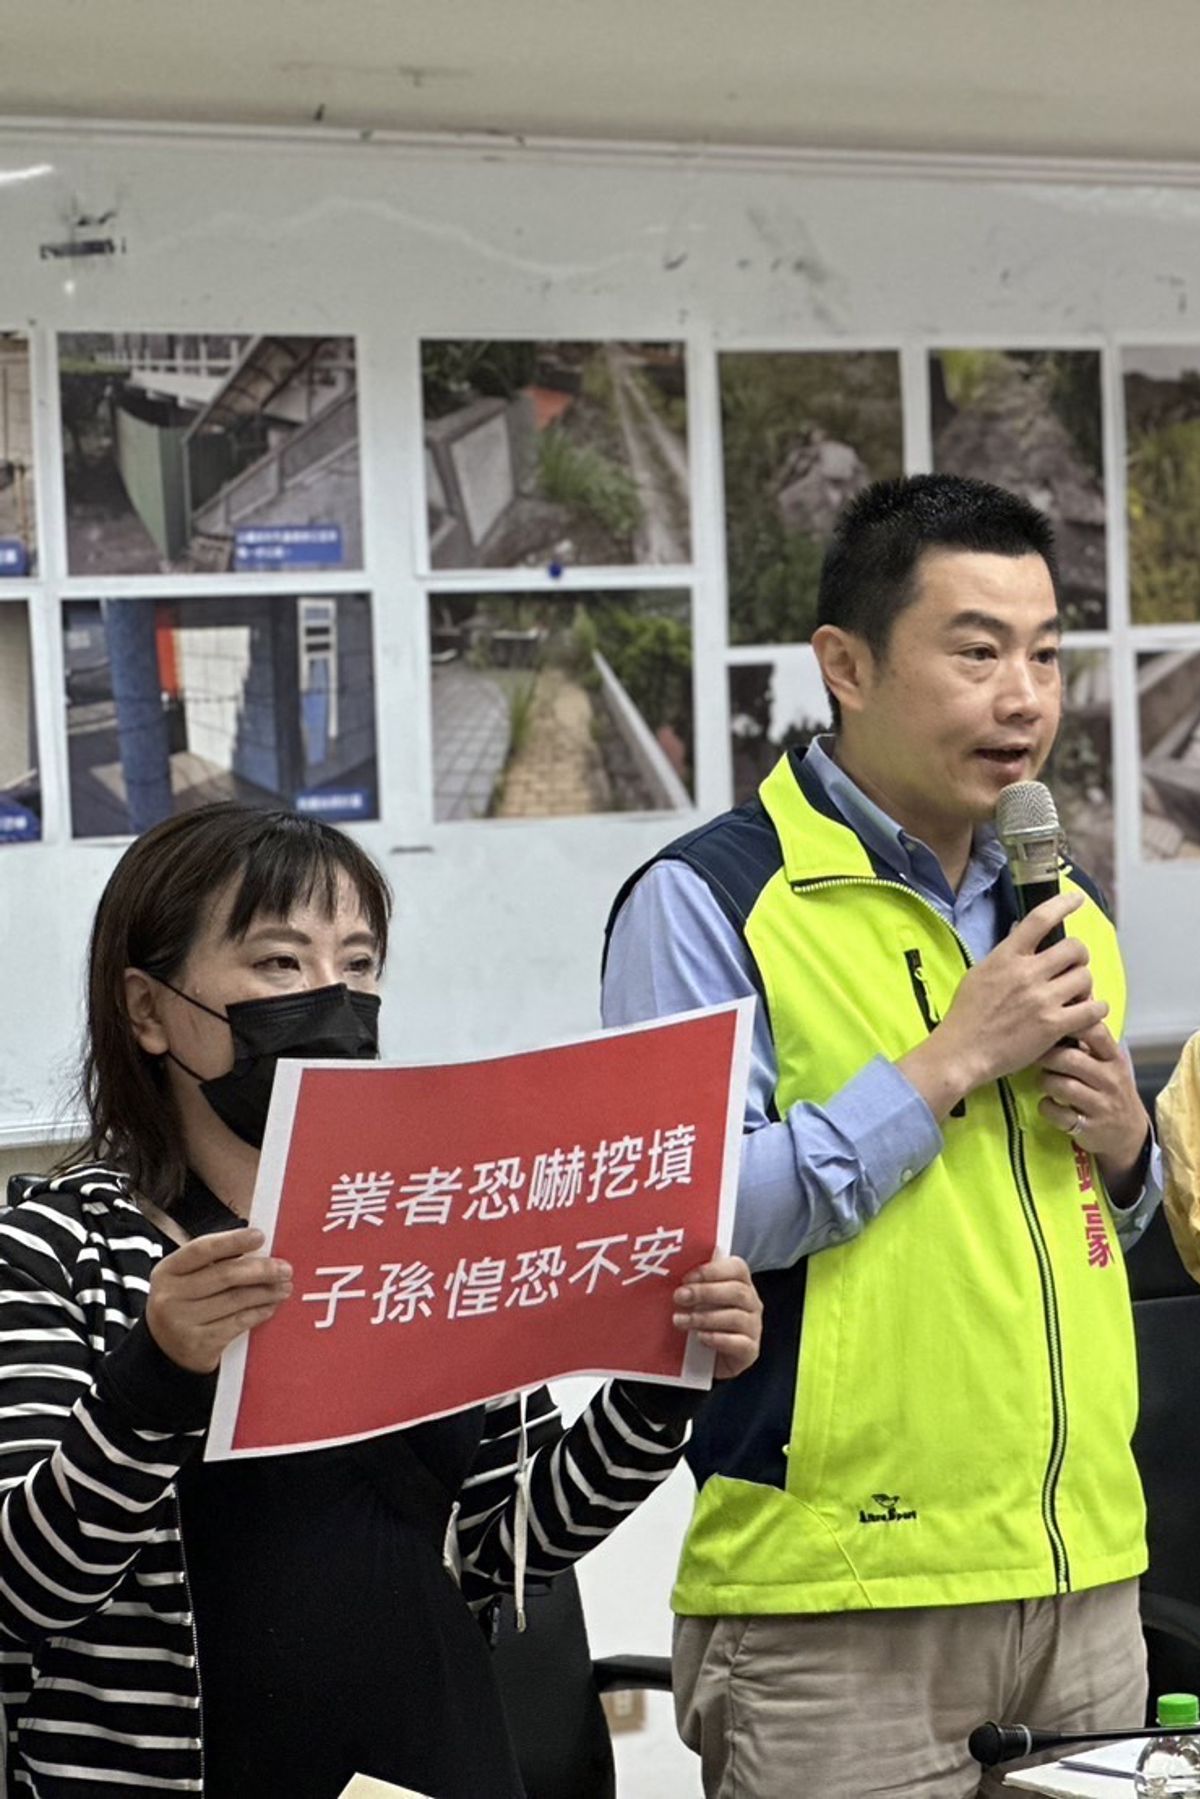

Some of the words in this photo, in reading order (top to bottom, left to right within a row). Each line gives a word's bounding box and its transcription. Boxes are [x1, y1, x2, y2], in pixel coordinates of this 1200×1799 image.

[321, 1123, 697, 1233] 業者恐嚇挖墳
[301, 1226, 686, 1329] 子孫惶恐不安
